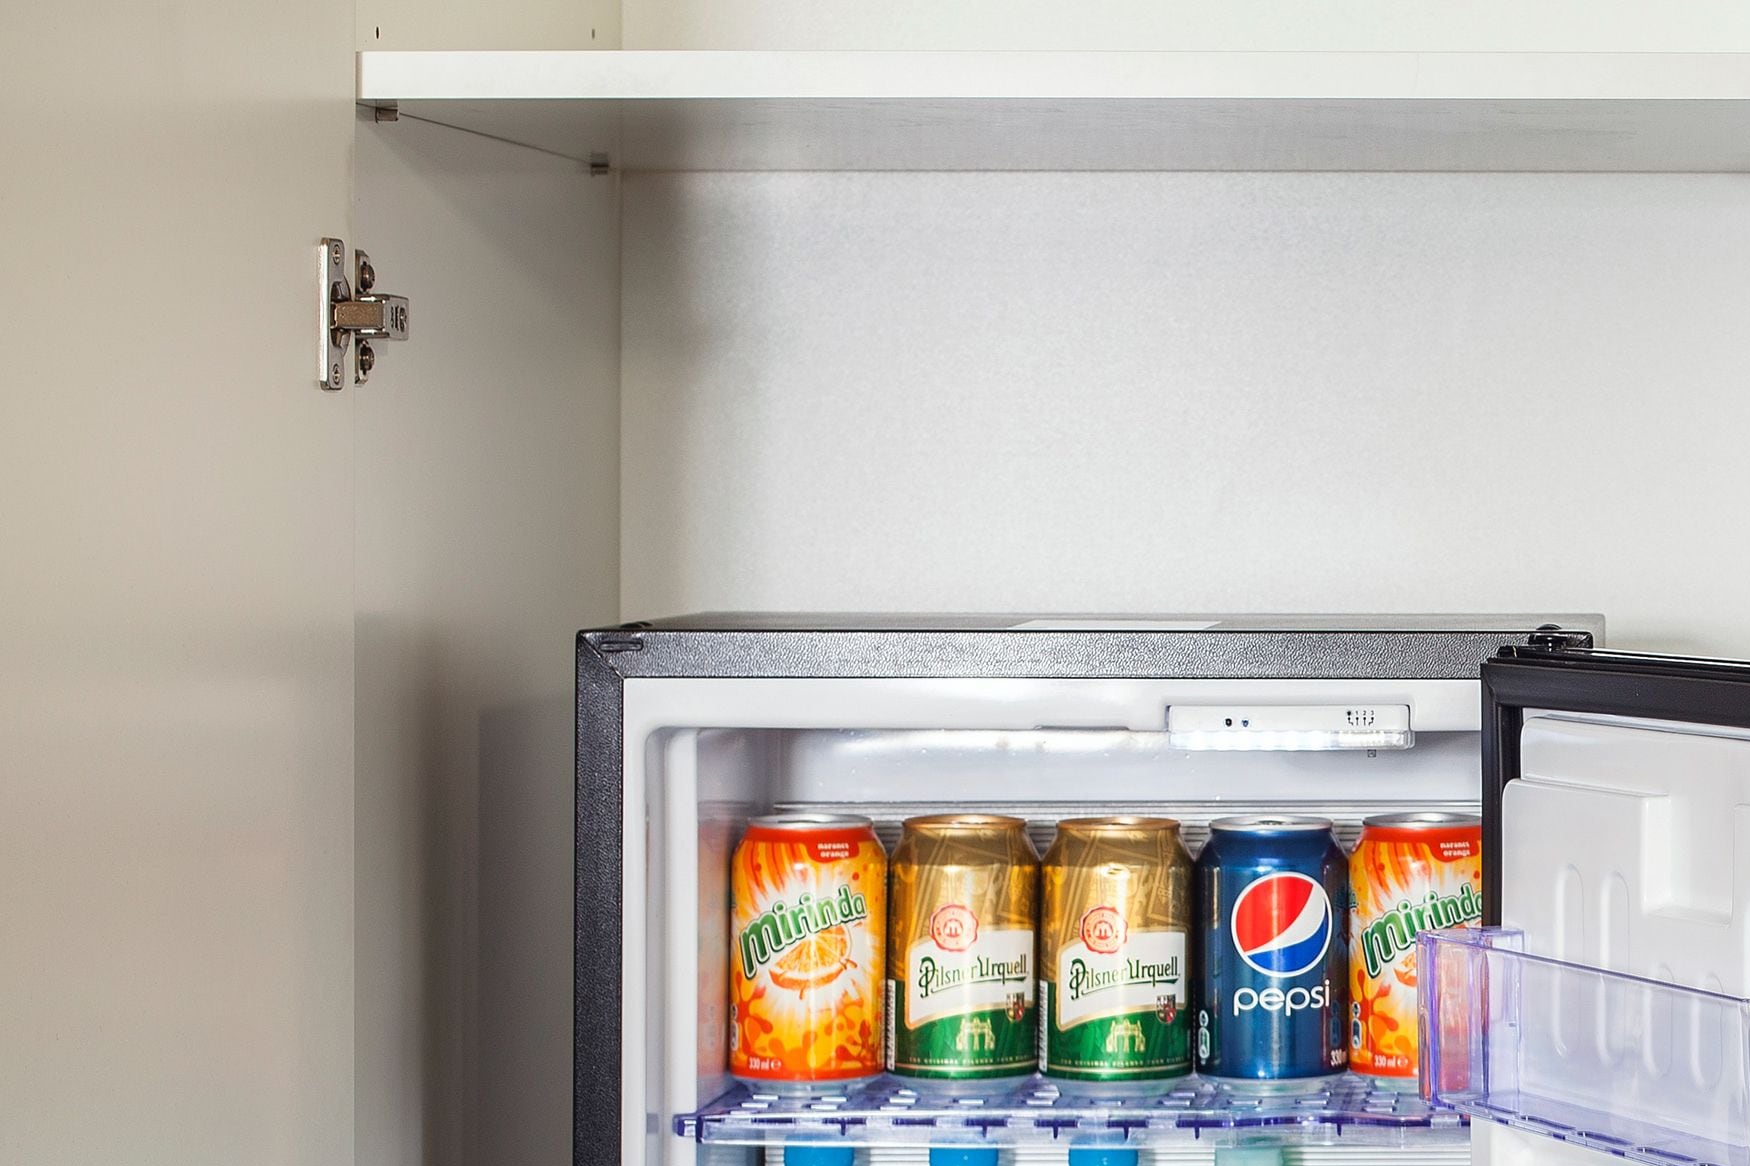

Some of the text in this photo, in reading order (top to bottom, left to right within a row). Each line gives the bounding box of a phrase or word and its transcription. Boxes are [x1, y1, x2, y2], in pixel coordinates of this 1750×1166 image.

[918, 953, 1027, 999] Pilsner Urquell
[1068, 956, 1178, 1001] Pilsner Urquell
[1233, 979, 1330, 1017] pepsi
[749, 1057, 760, 1070] 330
[1374, 1054, 1397, 1067] 330 ml
